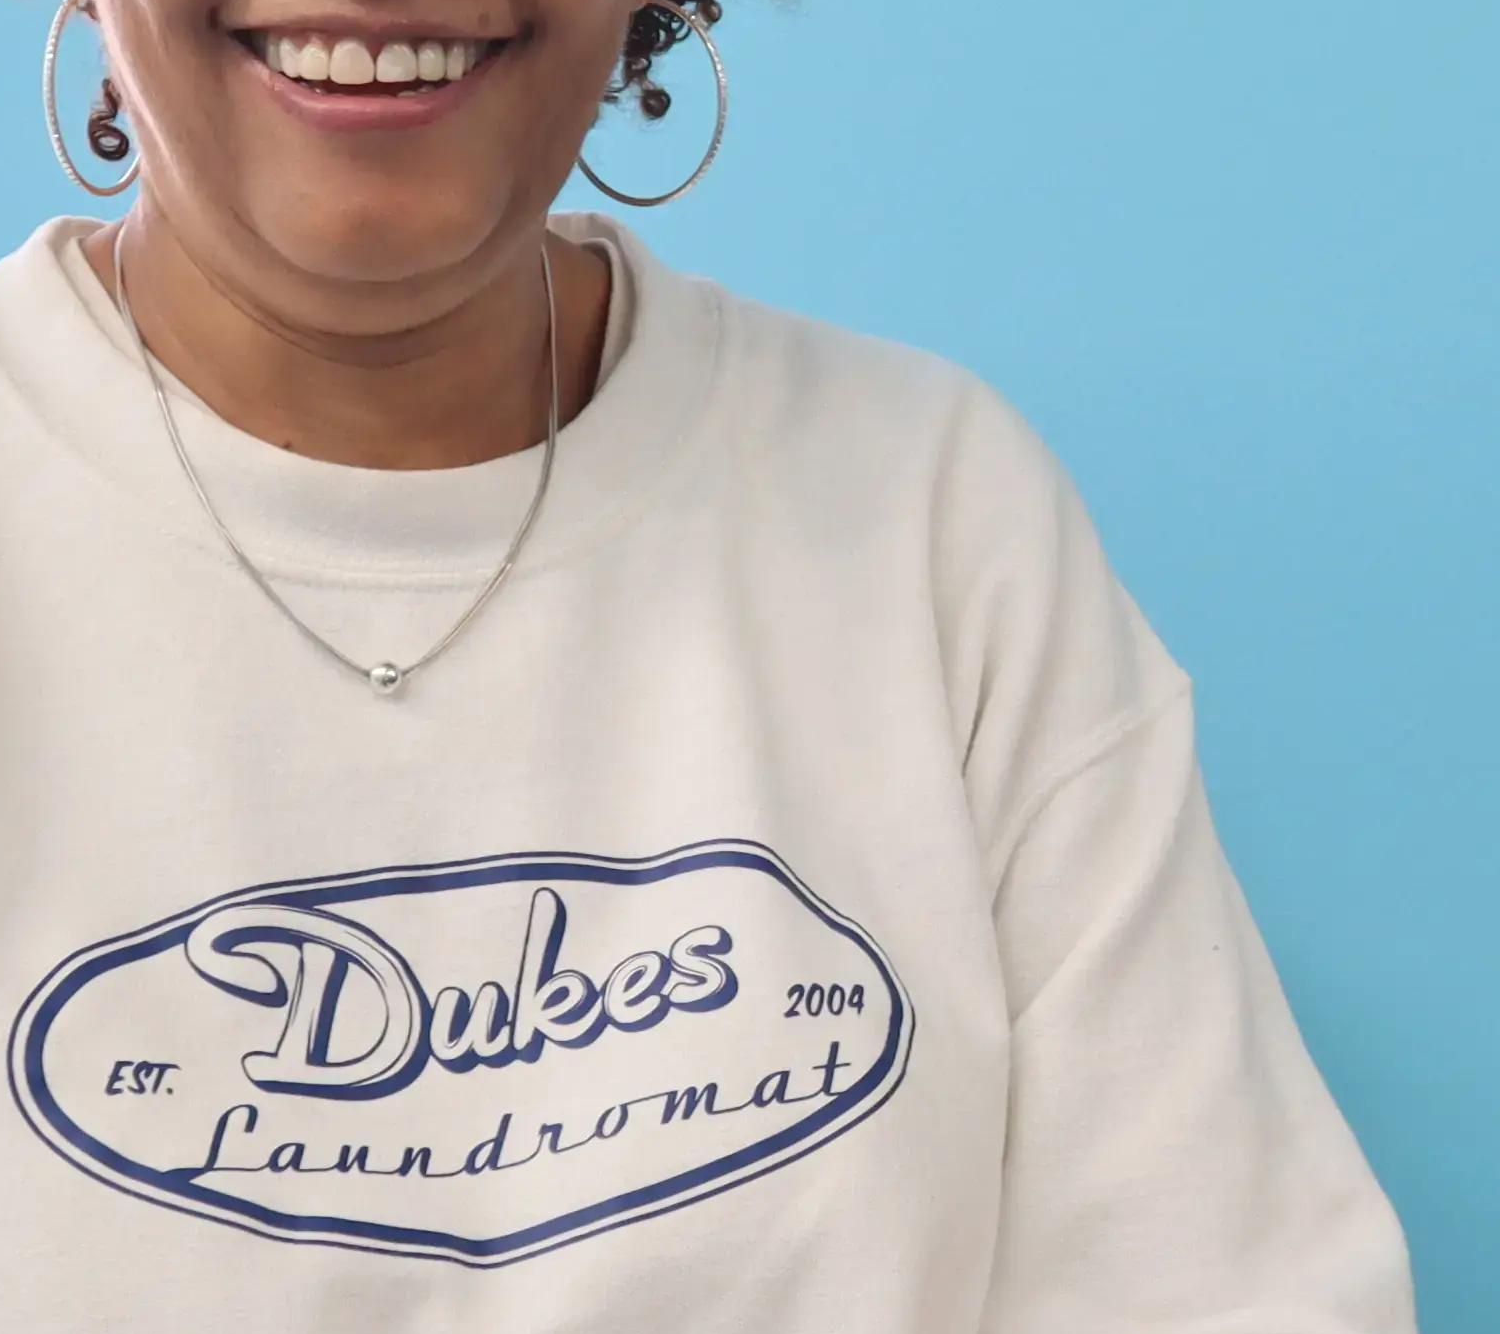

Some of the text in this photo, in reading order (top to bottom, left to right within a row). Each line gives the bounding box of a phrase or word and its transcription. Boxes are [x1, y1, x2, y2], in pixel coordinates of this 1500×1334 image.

[185, 887, 739, 1102] Dukes
[783, 983, 865, 1019] 2004
[105, 1061, 181, 1096] EST.
[172, 1040, 854, 1180] Laundromat
